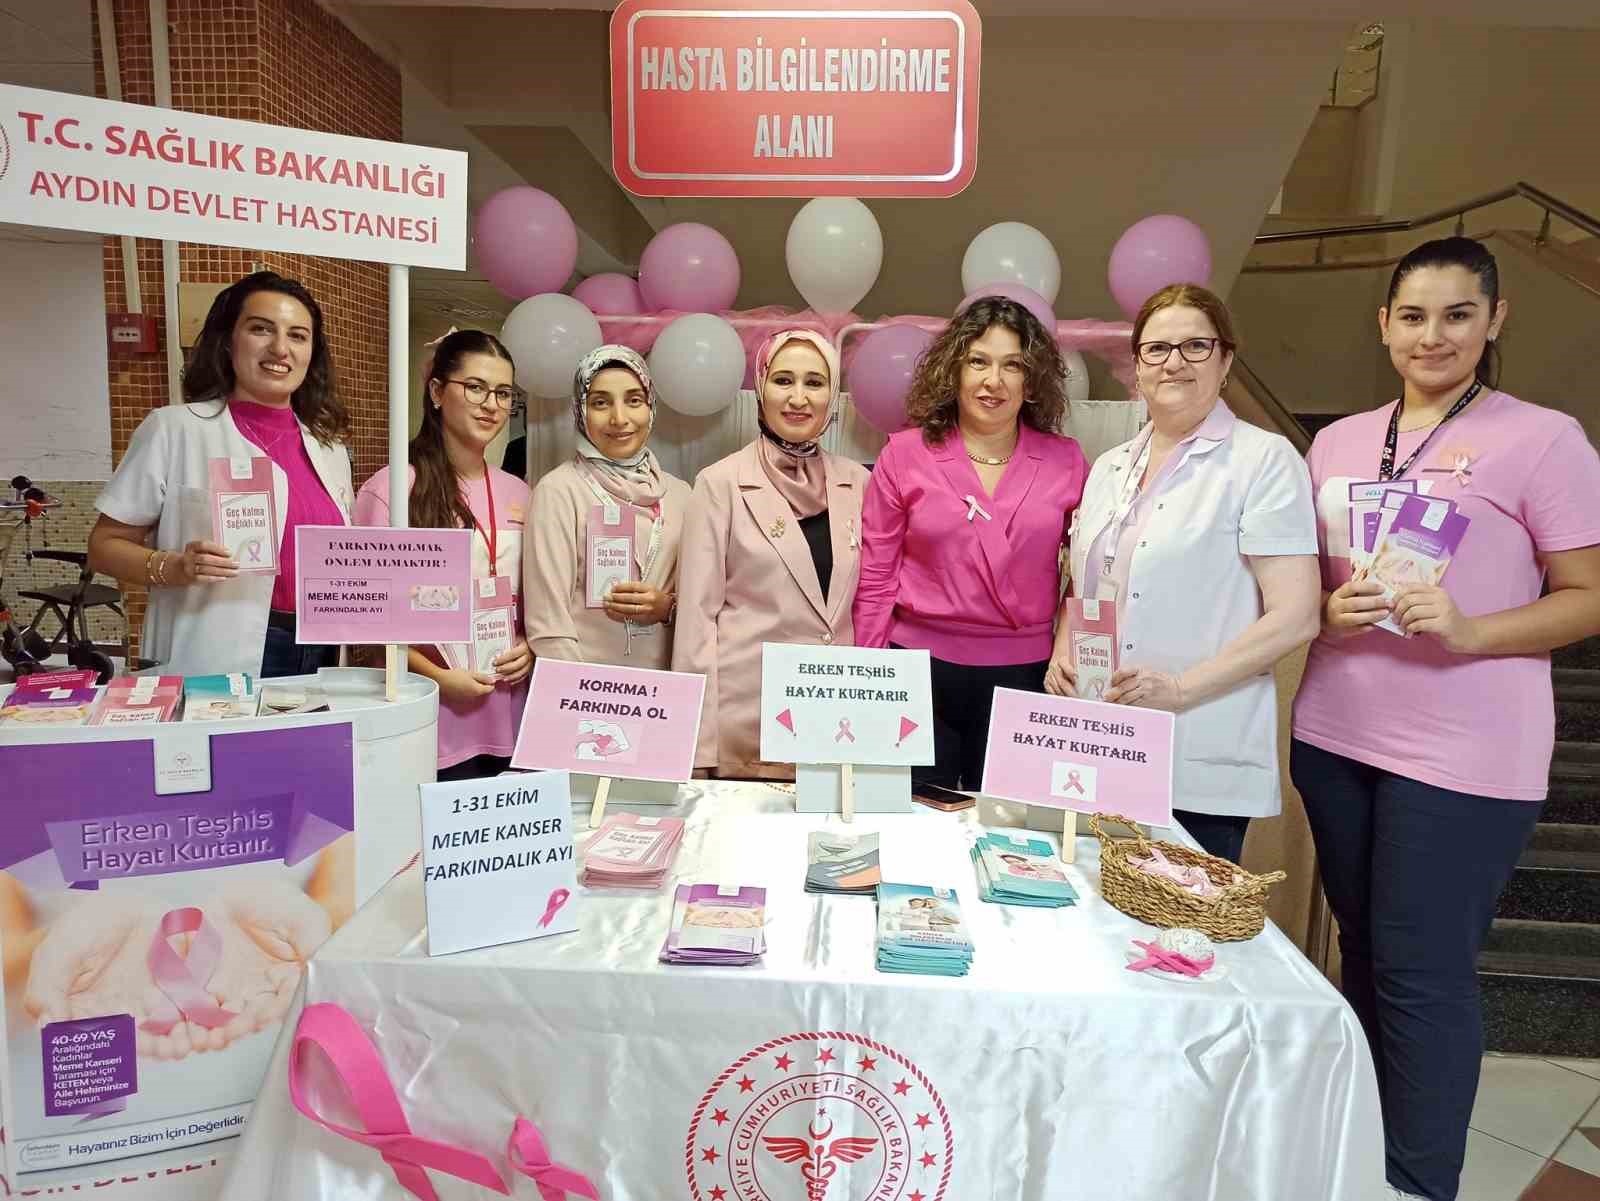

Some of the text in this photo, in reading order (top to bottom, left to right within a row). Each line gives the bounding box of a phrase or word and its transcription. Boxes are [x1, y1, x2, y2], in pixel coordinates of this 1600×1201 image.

[641, 36, 951, 93] HASTA BİLGİLENDİRME
[753, 114, 834, 159] ALANI
[18, 111, 446, 199] T.C. SAĞLIK BAKANLIĞI
[30, 171, 438, 243] AYDIN DEVLET HASTANESİ
[329, 541, 443, 553] FARKINDA OLMAK
[375, 558, 441, 568] ALMAKTIR
[347, 579, 368, 588] EKİM
[308, 591, 388, 601] MEME KANSERİ
[798, 663, 896, 680] ERKEN TEŞHİS
[579, 679, 658, 698] KORKMA !
[785, 685, 909, 702] HAYAT KURTARIR
[559, 699, 668, 720] FARKINDA OL
[1029, 711, 1136, 738] ERKEN TEŞHİS
[1013, 732, 1147, 763] HAYAT KURTARIR
[451, 788, 540, 814] 1-31 EKİM
[81, 807, 273, 846] Erken Teşhis
[431, 817, 562, 851] MEME KANSER
[82, 836, 273, 872] Hayat Kurtarır.
[423, 844, 574, 883] FARKINDALIK AYI
[51, 1028, 117, 1046] 40-69 YAŞ
[53, 1056, 122, 1072] Meme Kanseri
[53, 1069, 97, 1080] Taraması
[53, 1079, 89, 1090] KETEM
[54, 1089, 74, 1099] Aile
[736, 1077, 840, 1150] CUMHURİYETİ
[844, 1079, 898, 1132] SAĞLIK
[68, 1138, 128, 1155] Hayatınız
[129, 1132, 164, 1146] Bizim
[165, 1127, 187, 1140] İçin
